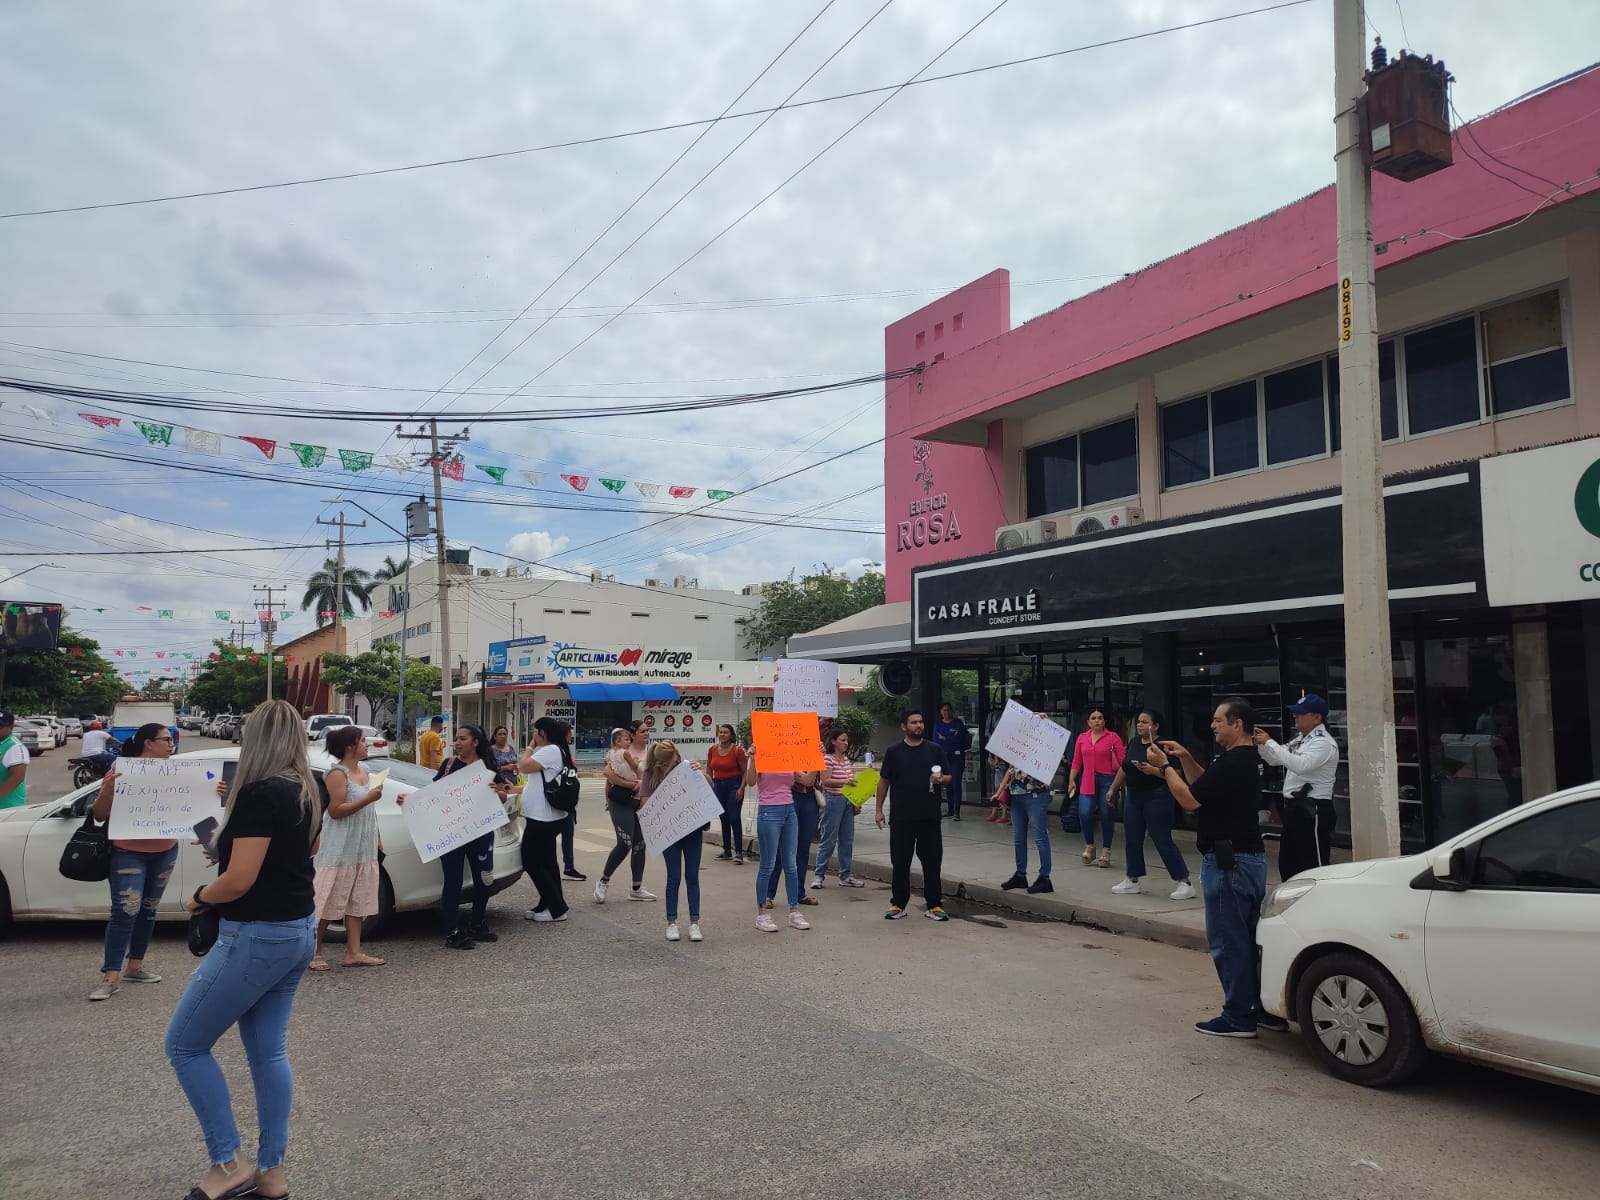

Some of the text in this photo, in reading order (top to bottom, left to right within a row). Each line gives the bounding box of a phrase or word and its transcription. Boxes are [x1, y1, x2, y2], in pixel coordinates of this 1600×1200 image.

[1342, 278, 1351, 341] 08193
[910, 493, 947, 517] EDIFICIO
[897, 510, 961, 552] ROSA
[928, 588, 1036, 620] CASA FRALÉ
[989, 613, 1041, 625] CONCEPT STORE
[560, 652, 618, 663] ARTICLIMAS
[644, 648, 692, 669] mirage
[588, 669, 690, 677] DISTRIBUIDOR AUTORIZADO
[662, 690, 713, 710] mirage
[129, 802, 193, 816] un plan de
[159, 826, 194, 836] INMEDIA
